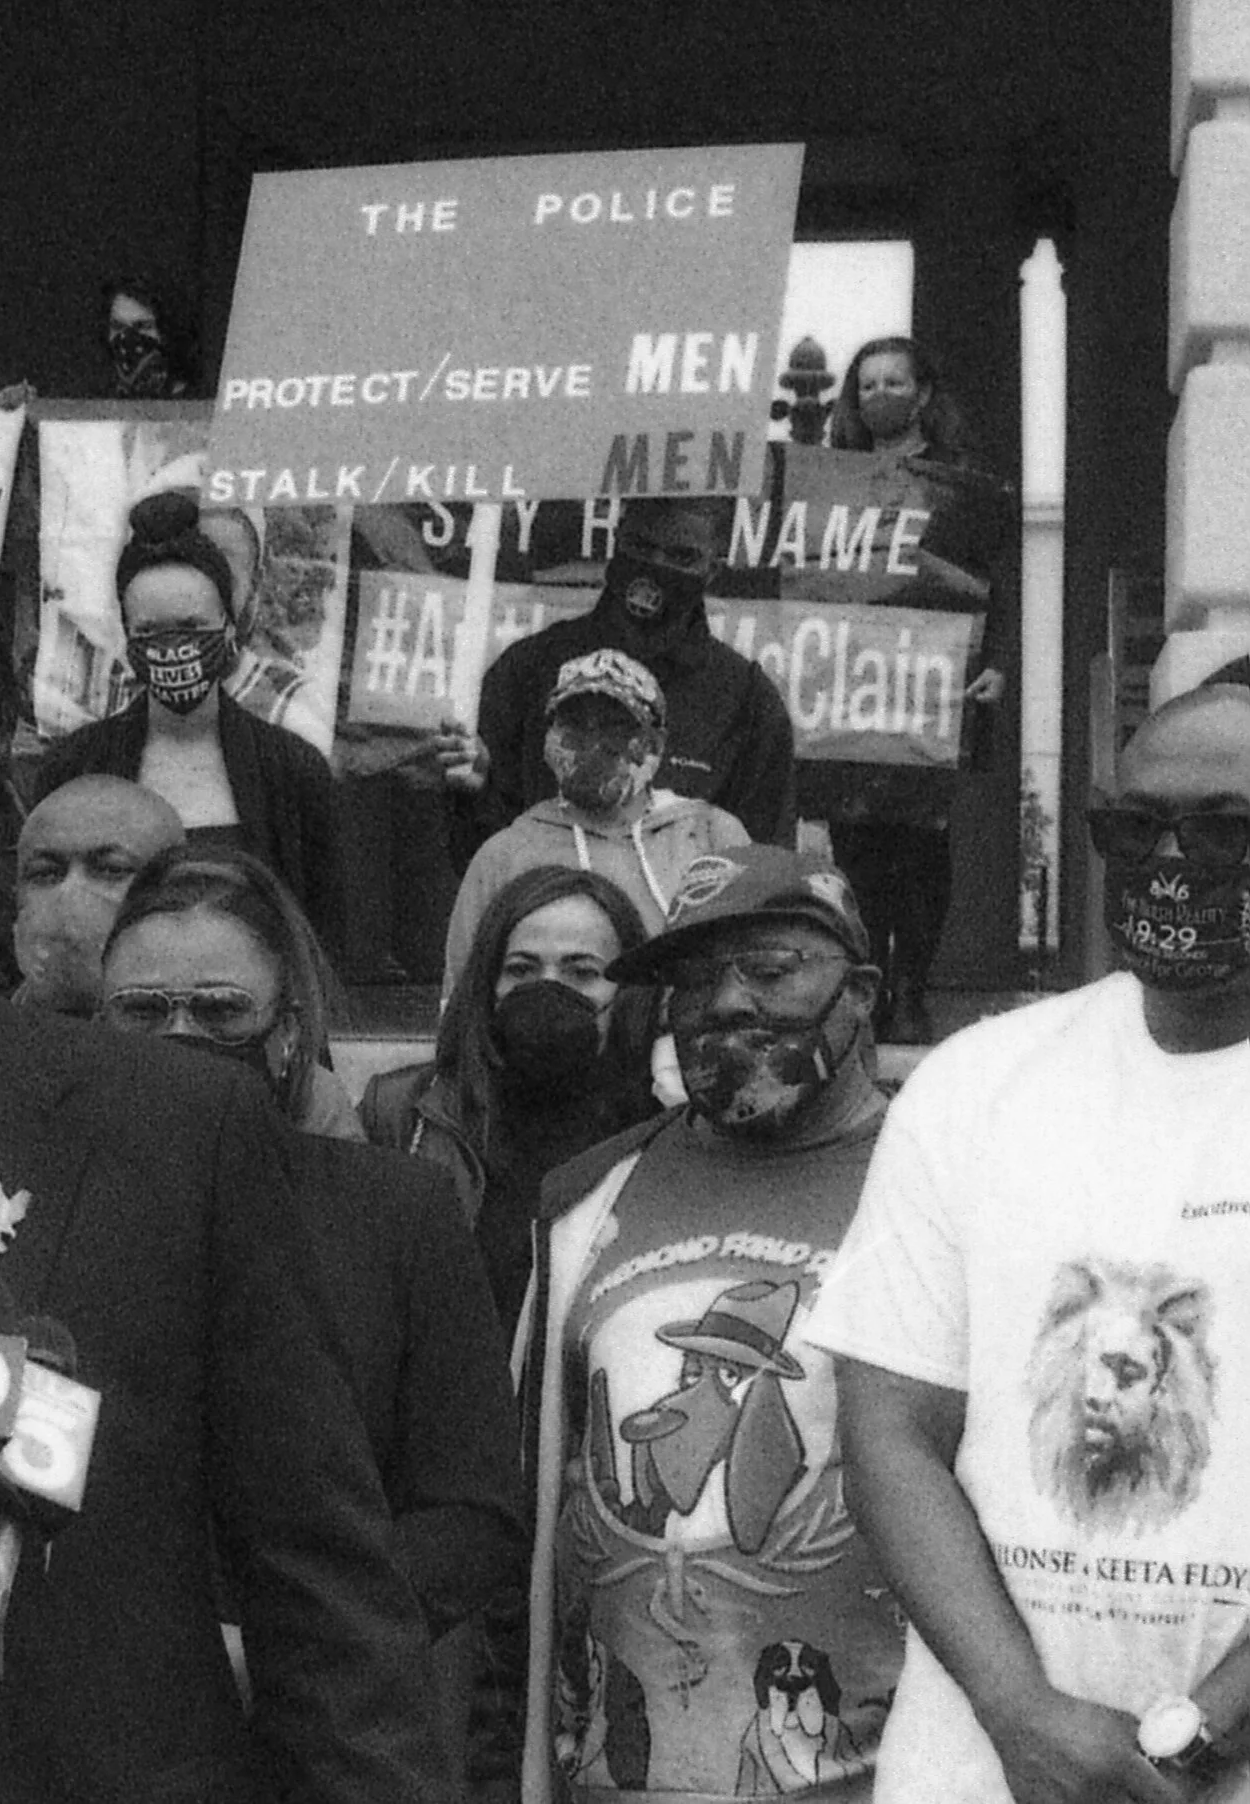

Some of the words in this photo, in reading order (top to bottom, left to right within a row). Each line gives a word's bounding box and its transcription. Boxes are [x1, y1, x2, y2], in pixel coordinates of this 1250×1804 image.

[361, 199, 458, 236] THE
[533, 183, 736, 226] POLICE
[625, 332, 759, 394] MEN
[600, 430, 745, 495] MEN
[726, 497, 931, 576] NAME
[1184, 1562, 1250, 1590] FLOY
